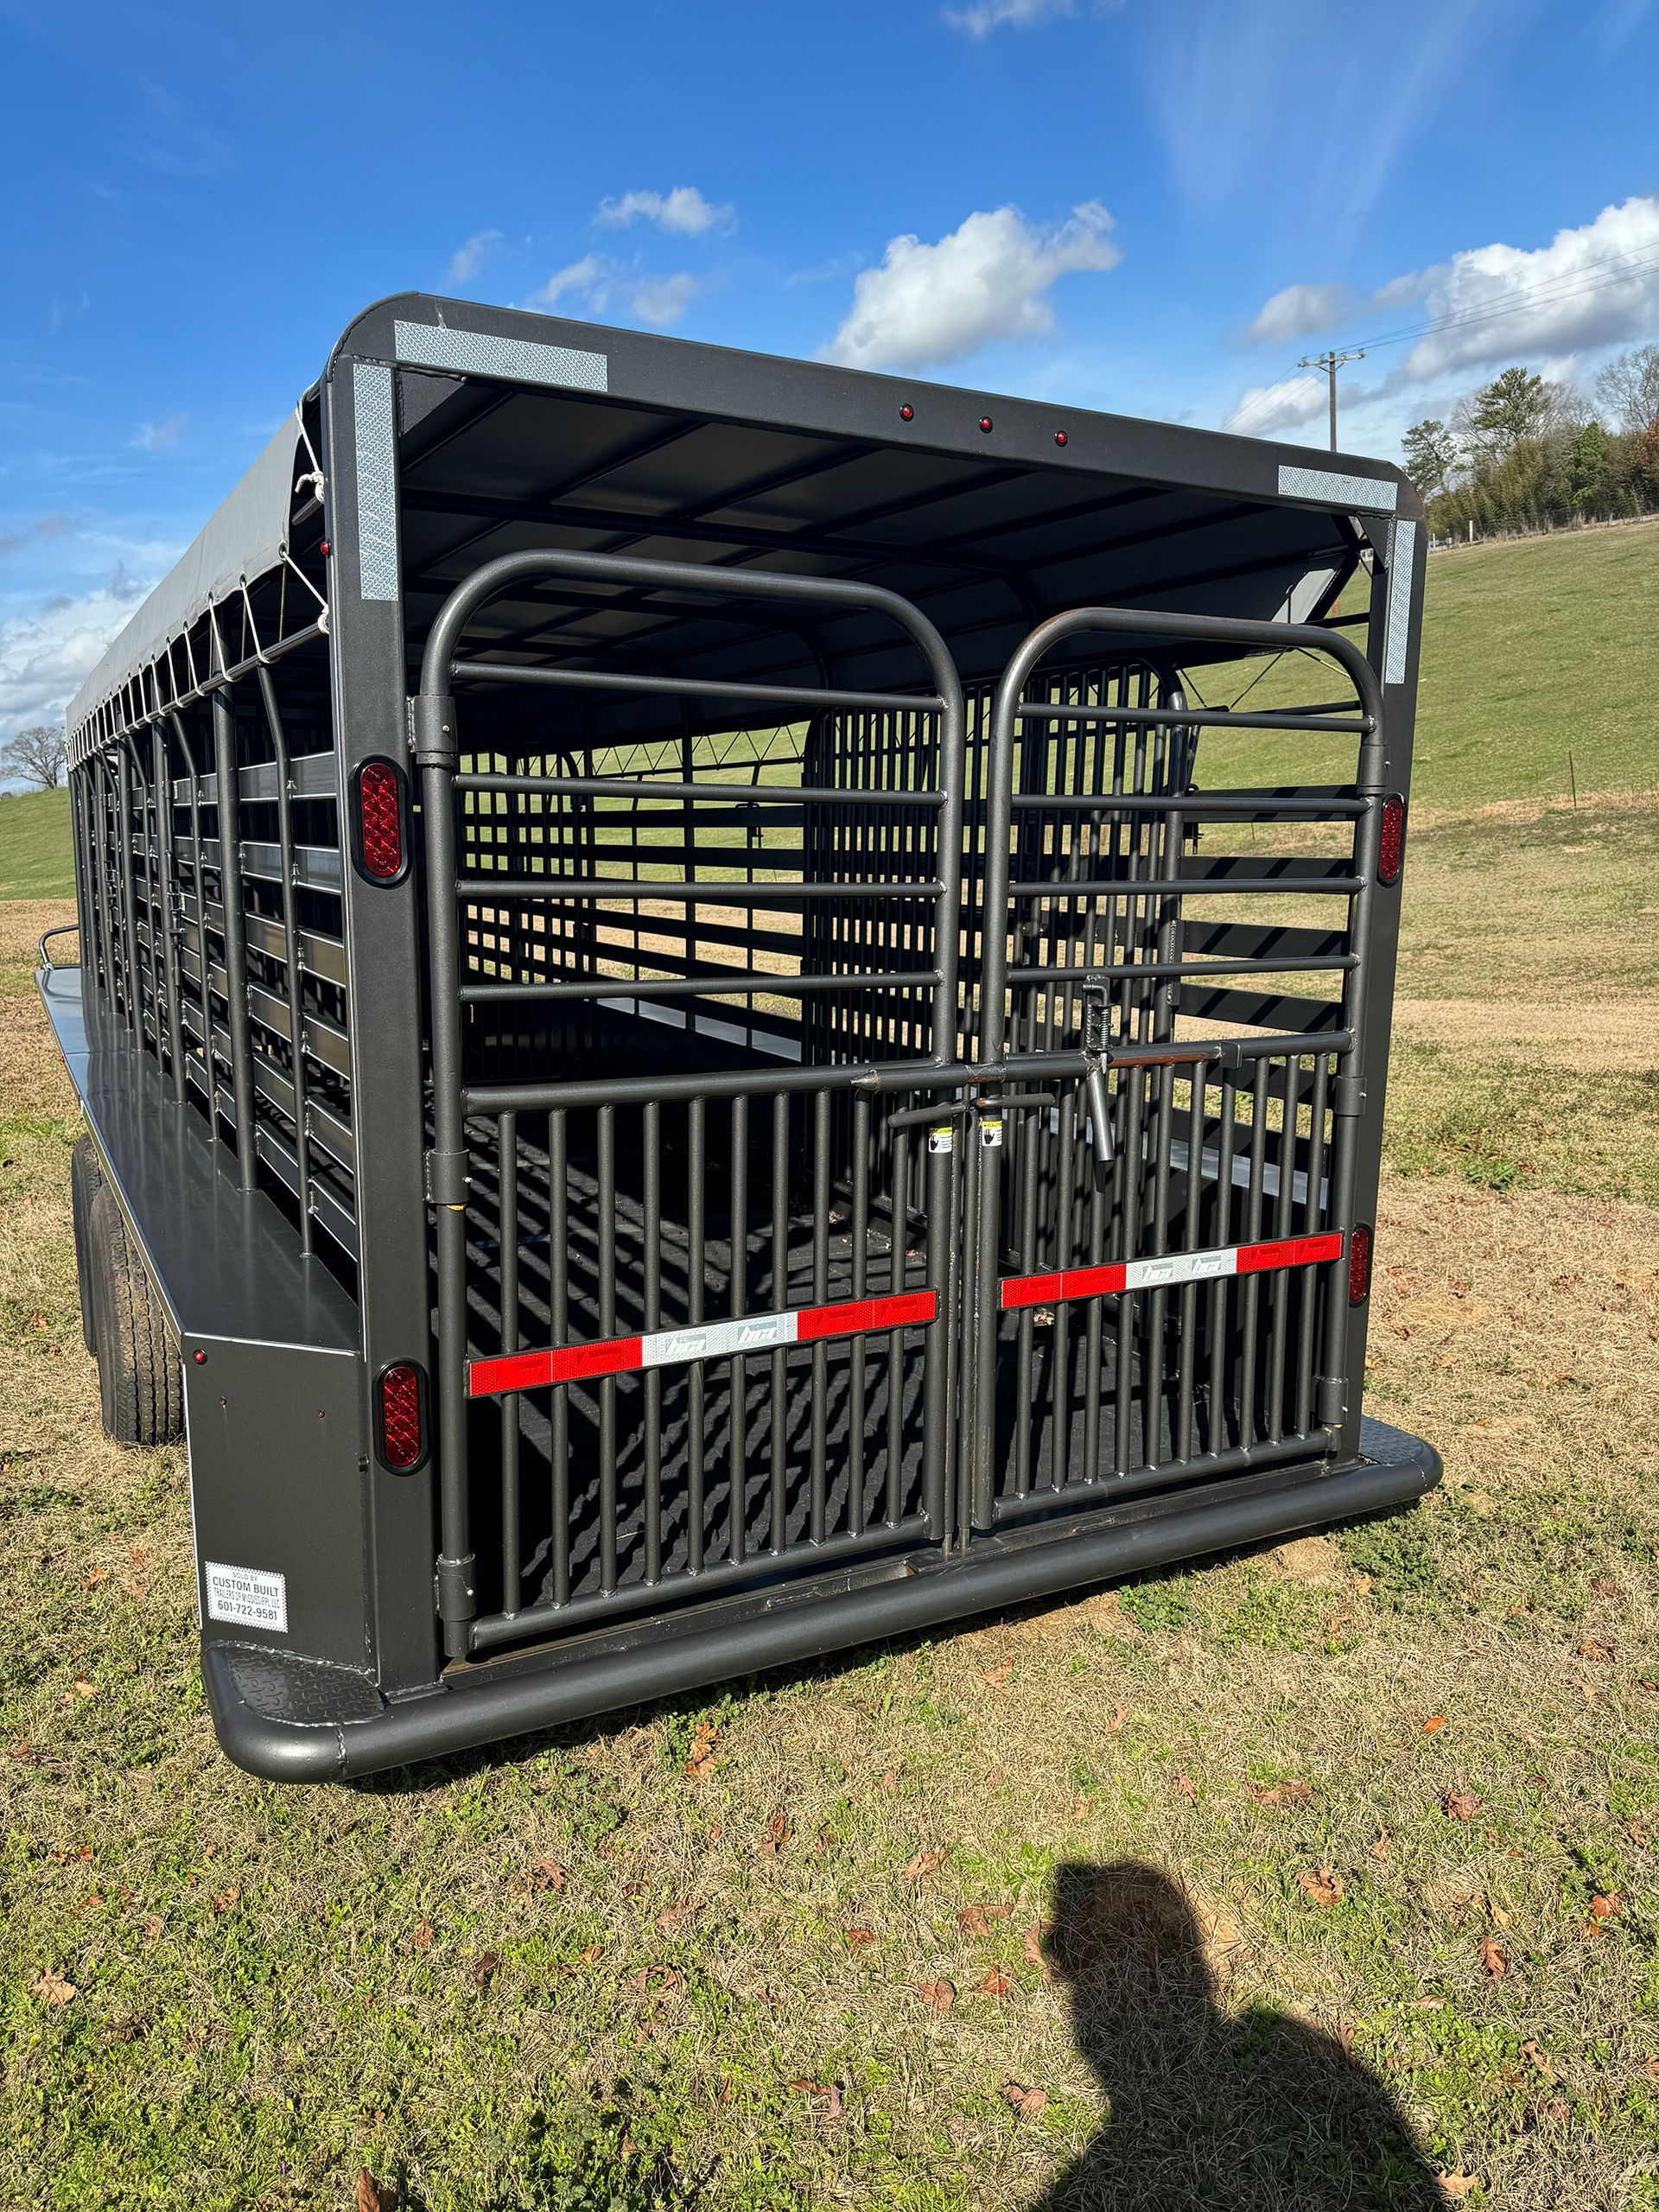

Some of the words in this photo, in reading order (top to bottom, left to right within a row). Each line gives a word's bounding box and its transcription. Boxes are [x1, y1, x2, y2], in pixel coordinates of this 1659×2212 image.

[232, 1572, 249, 1580] SOLD
[213, 1576, 251, 1592] CUSTOM
[253, 1584, 279, 1598] BUILT
[218, 1600, 277, 1621] 601-722-9581
